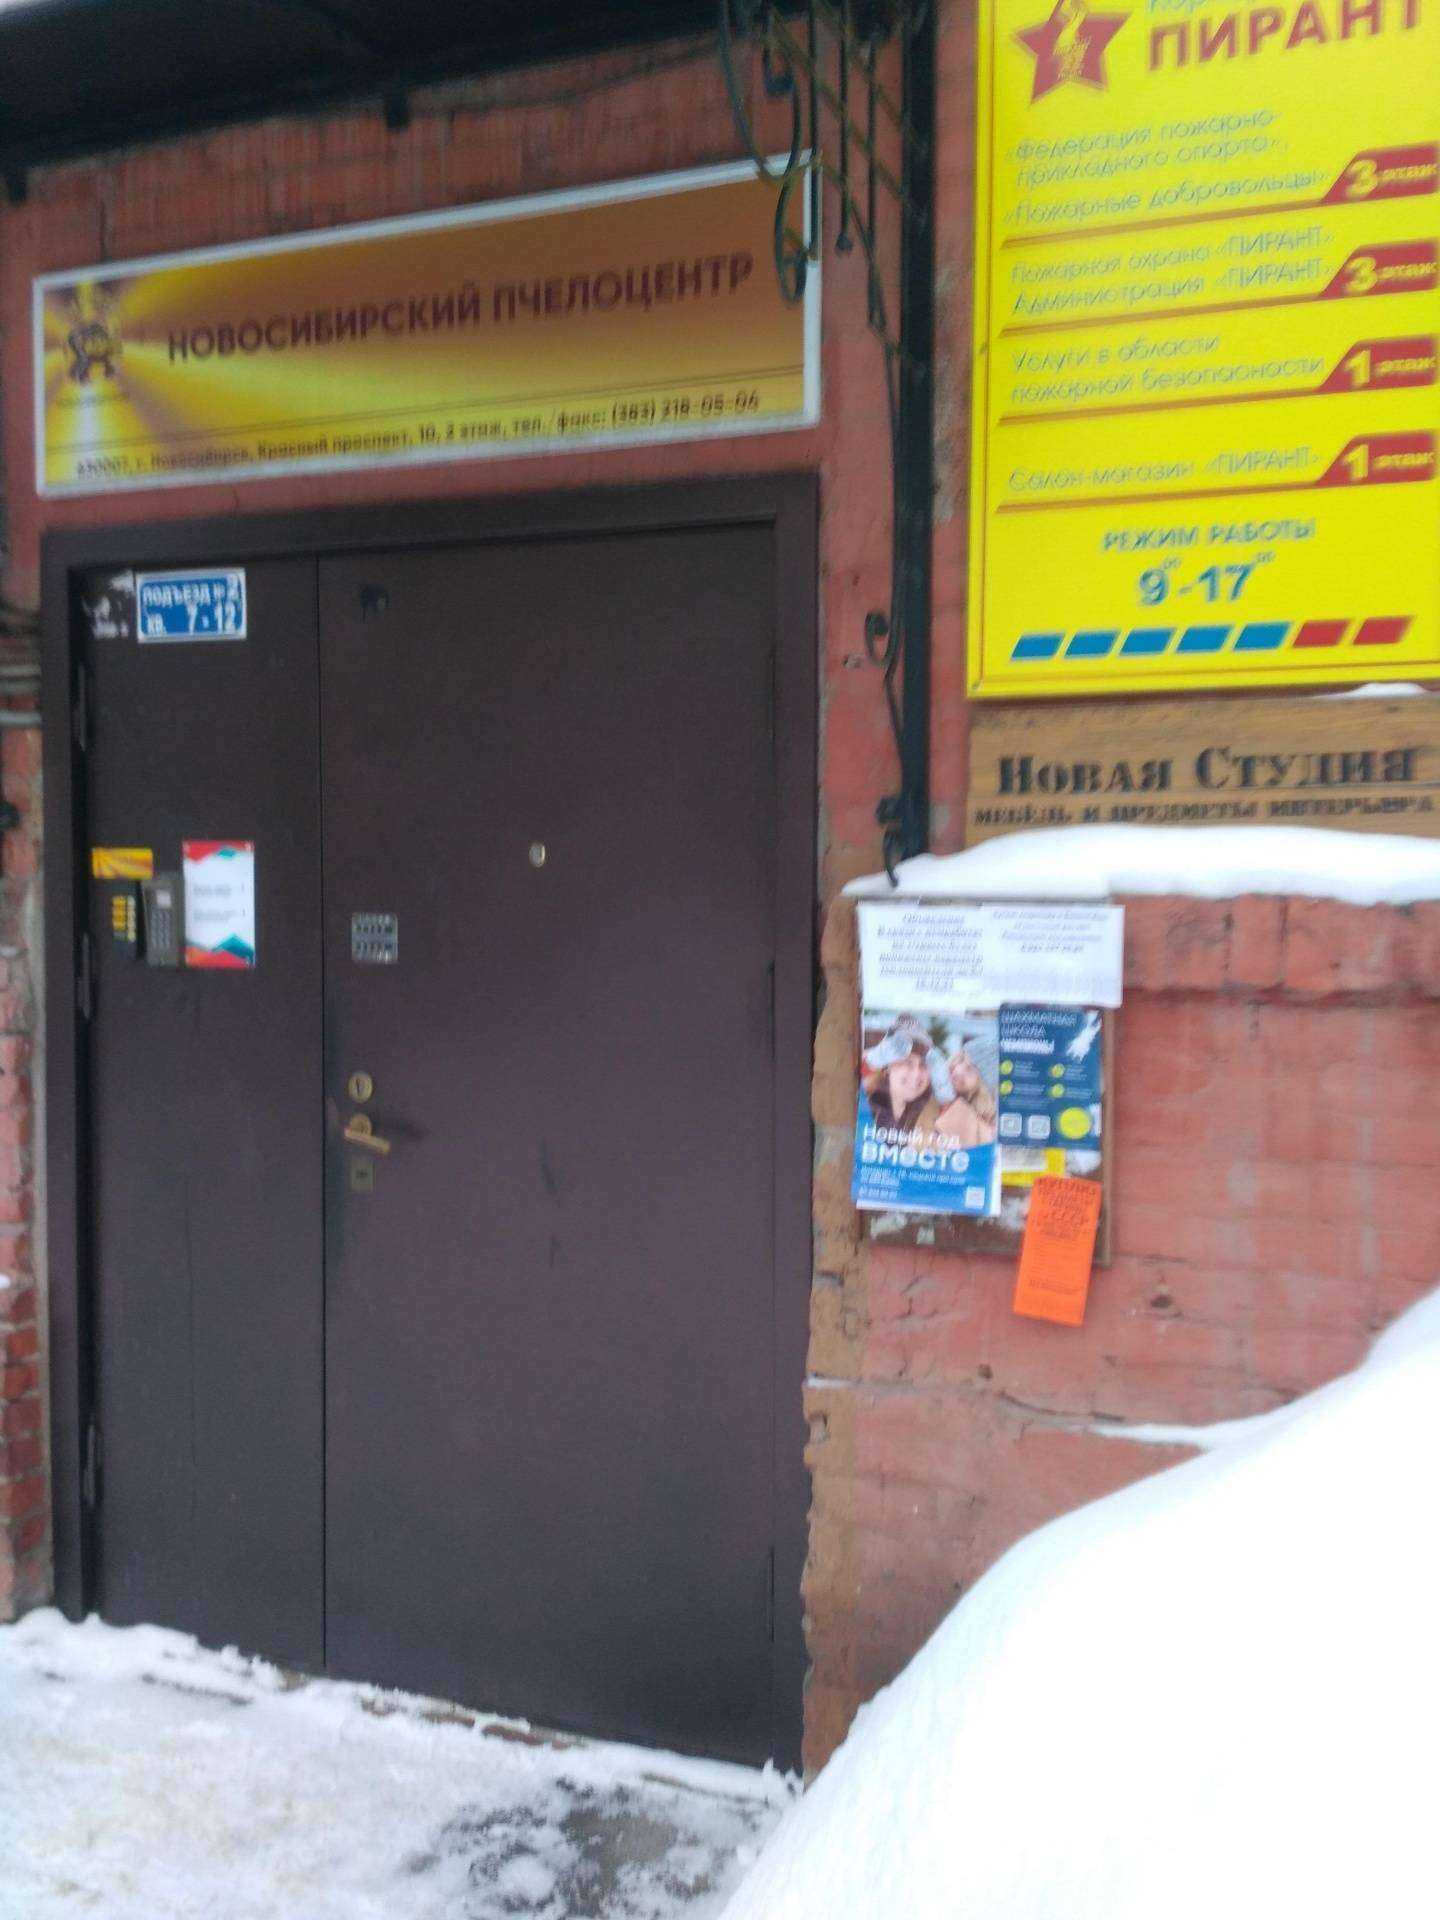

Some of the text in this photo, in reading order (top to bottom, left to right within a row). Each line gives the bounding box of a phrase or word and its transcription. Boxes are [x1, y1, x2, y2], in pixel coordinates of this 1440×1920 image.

[1345, 159, 1378, 197] 3
[1345, 256, 1378, 291] 3
[167, 251, 755, 365] НОВОСИБИРСКИЙ ПЧЕЛОЦЕНТР
[1344, 350, 1371, 386] 1
[1342, 443, 1369, 480] 1
[1102, 517, 1317, 551] РЕЖИМ РАБОТЫ
[214, 599, 237, 635] 12
